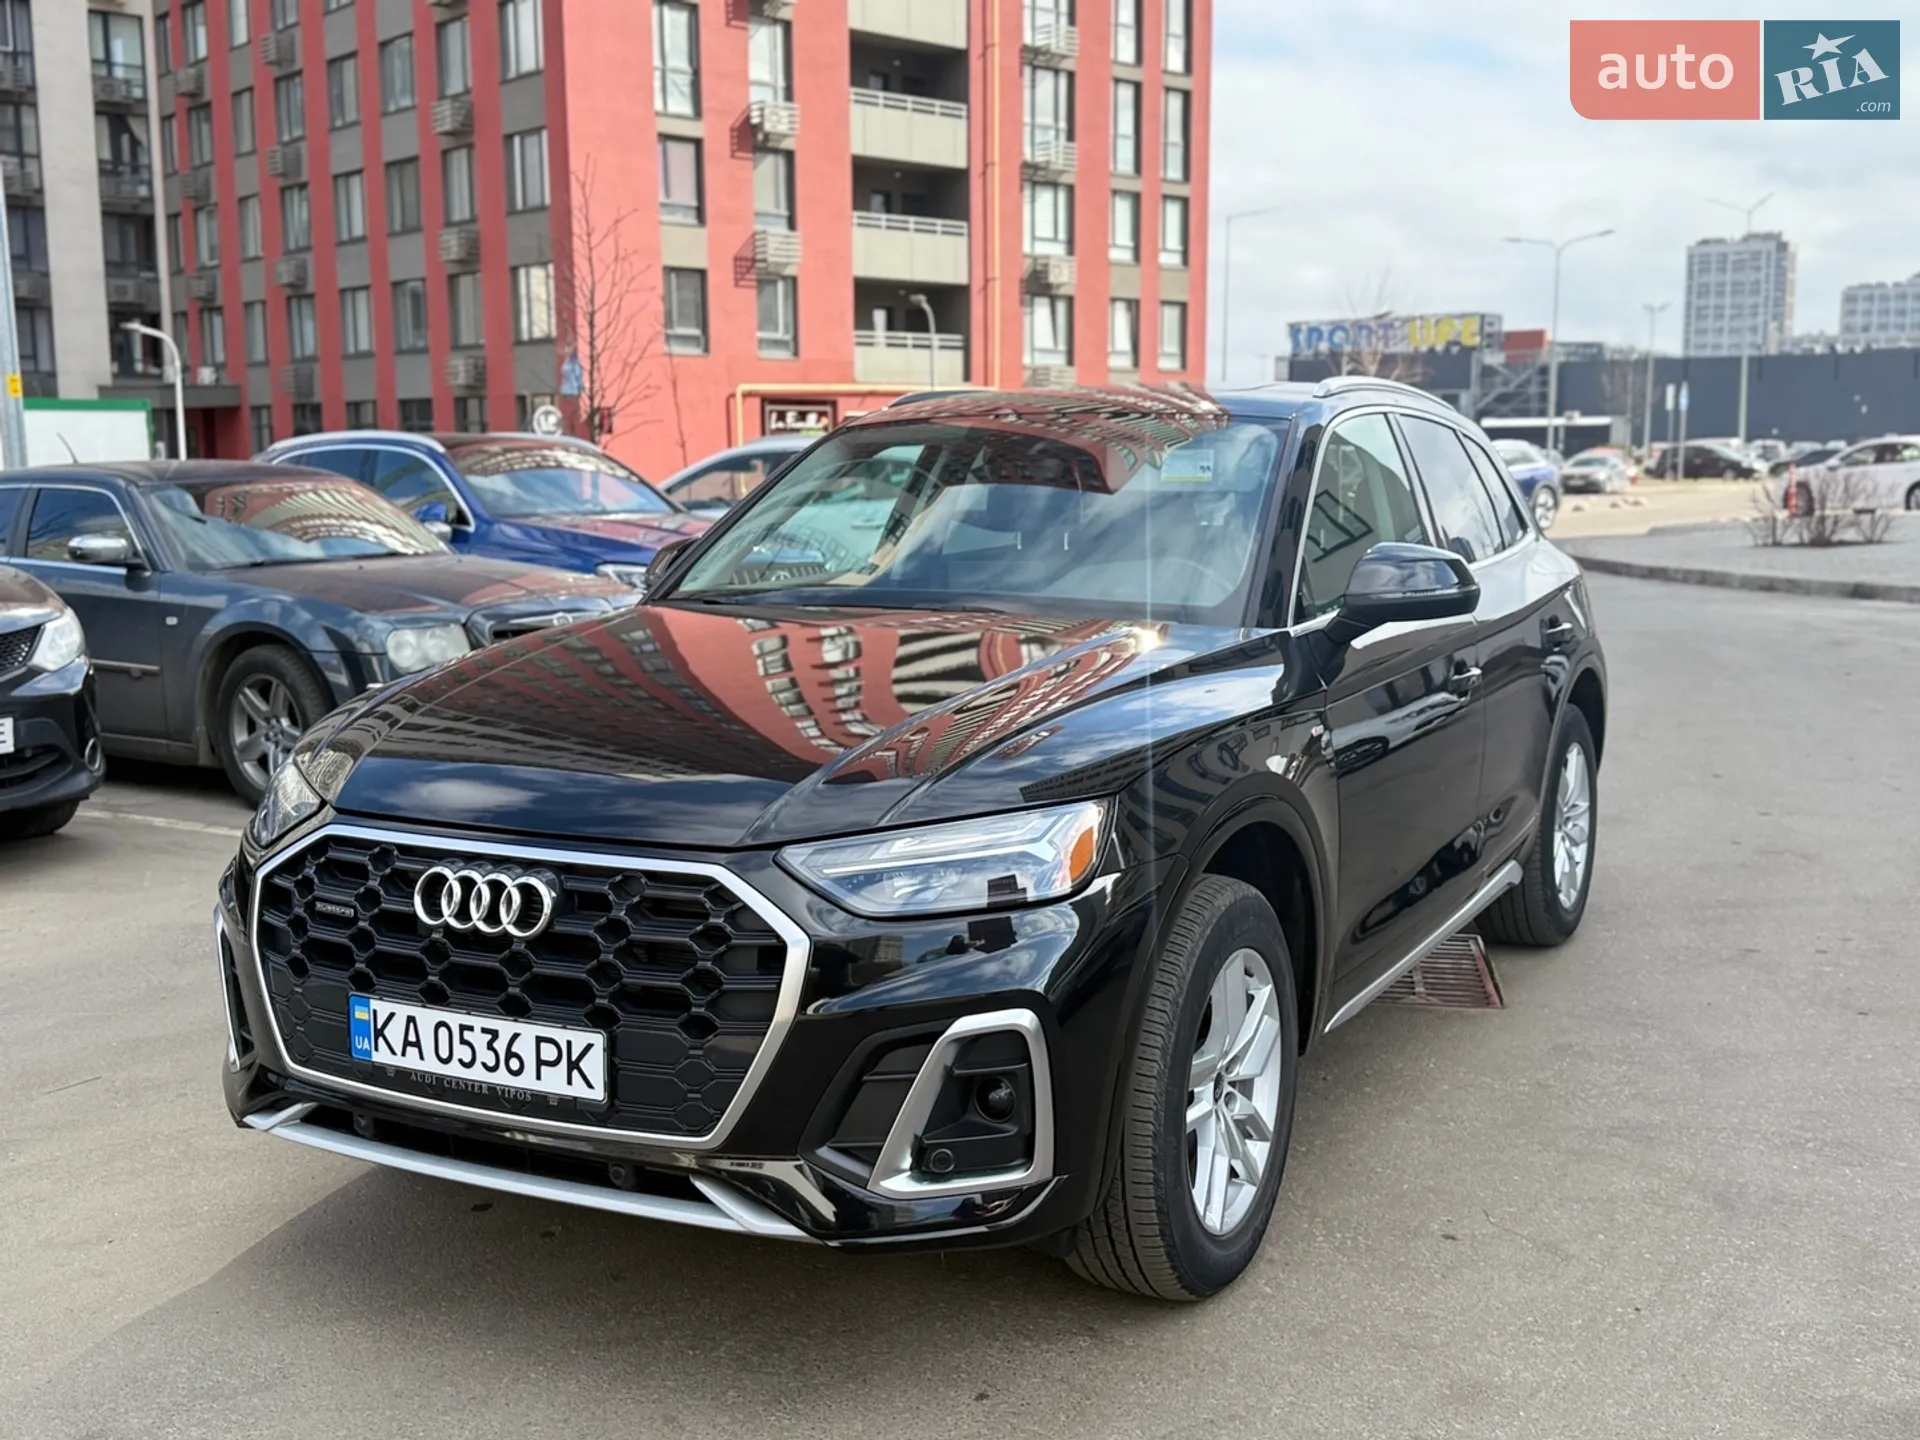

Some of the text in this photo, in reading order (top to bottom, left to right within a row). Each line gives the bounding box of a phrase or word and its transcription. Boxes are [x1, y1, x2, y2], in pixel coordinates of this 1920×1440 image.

[1291, 322, 1394, 351] SPORT
[355, 1034, 370, 1051] UA
[372, 1008, 596, 1090] KA 0536 PK
[410, 1071, 437, 1085] AUDI
[443, 1077, 489, 1095] CENTER
